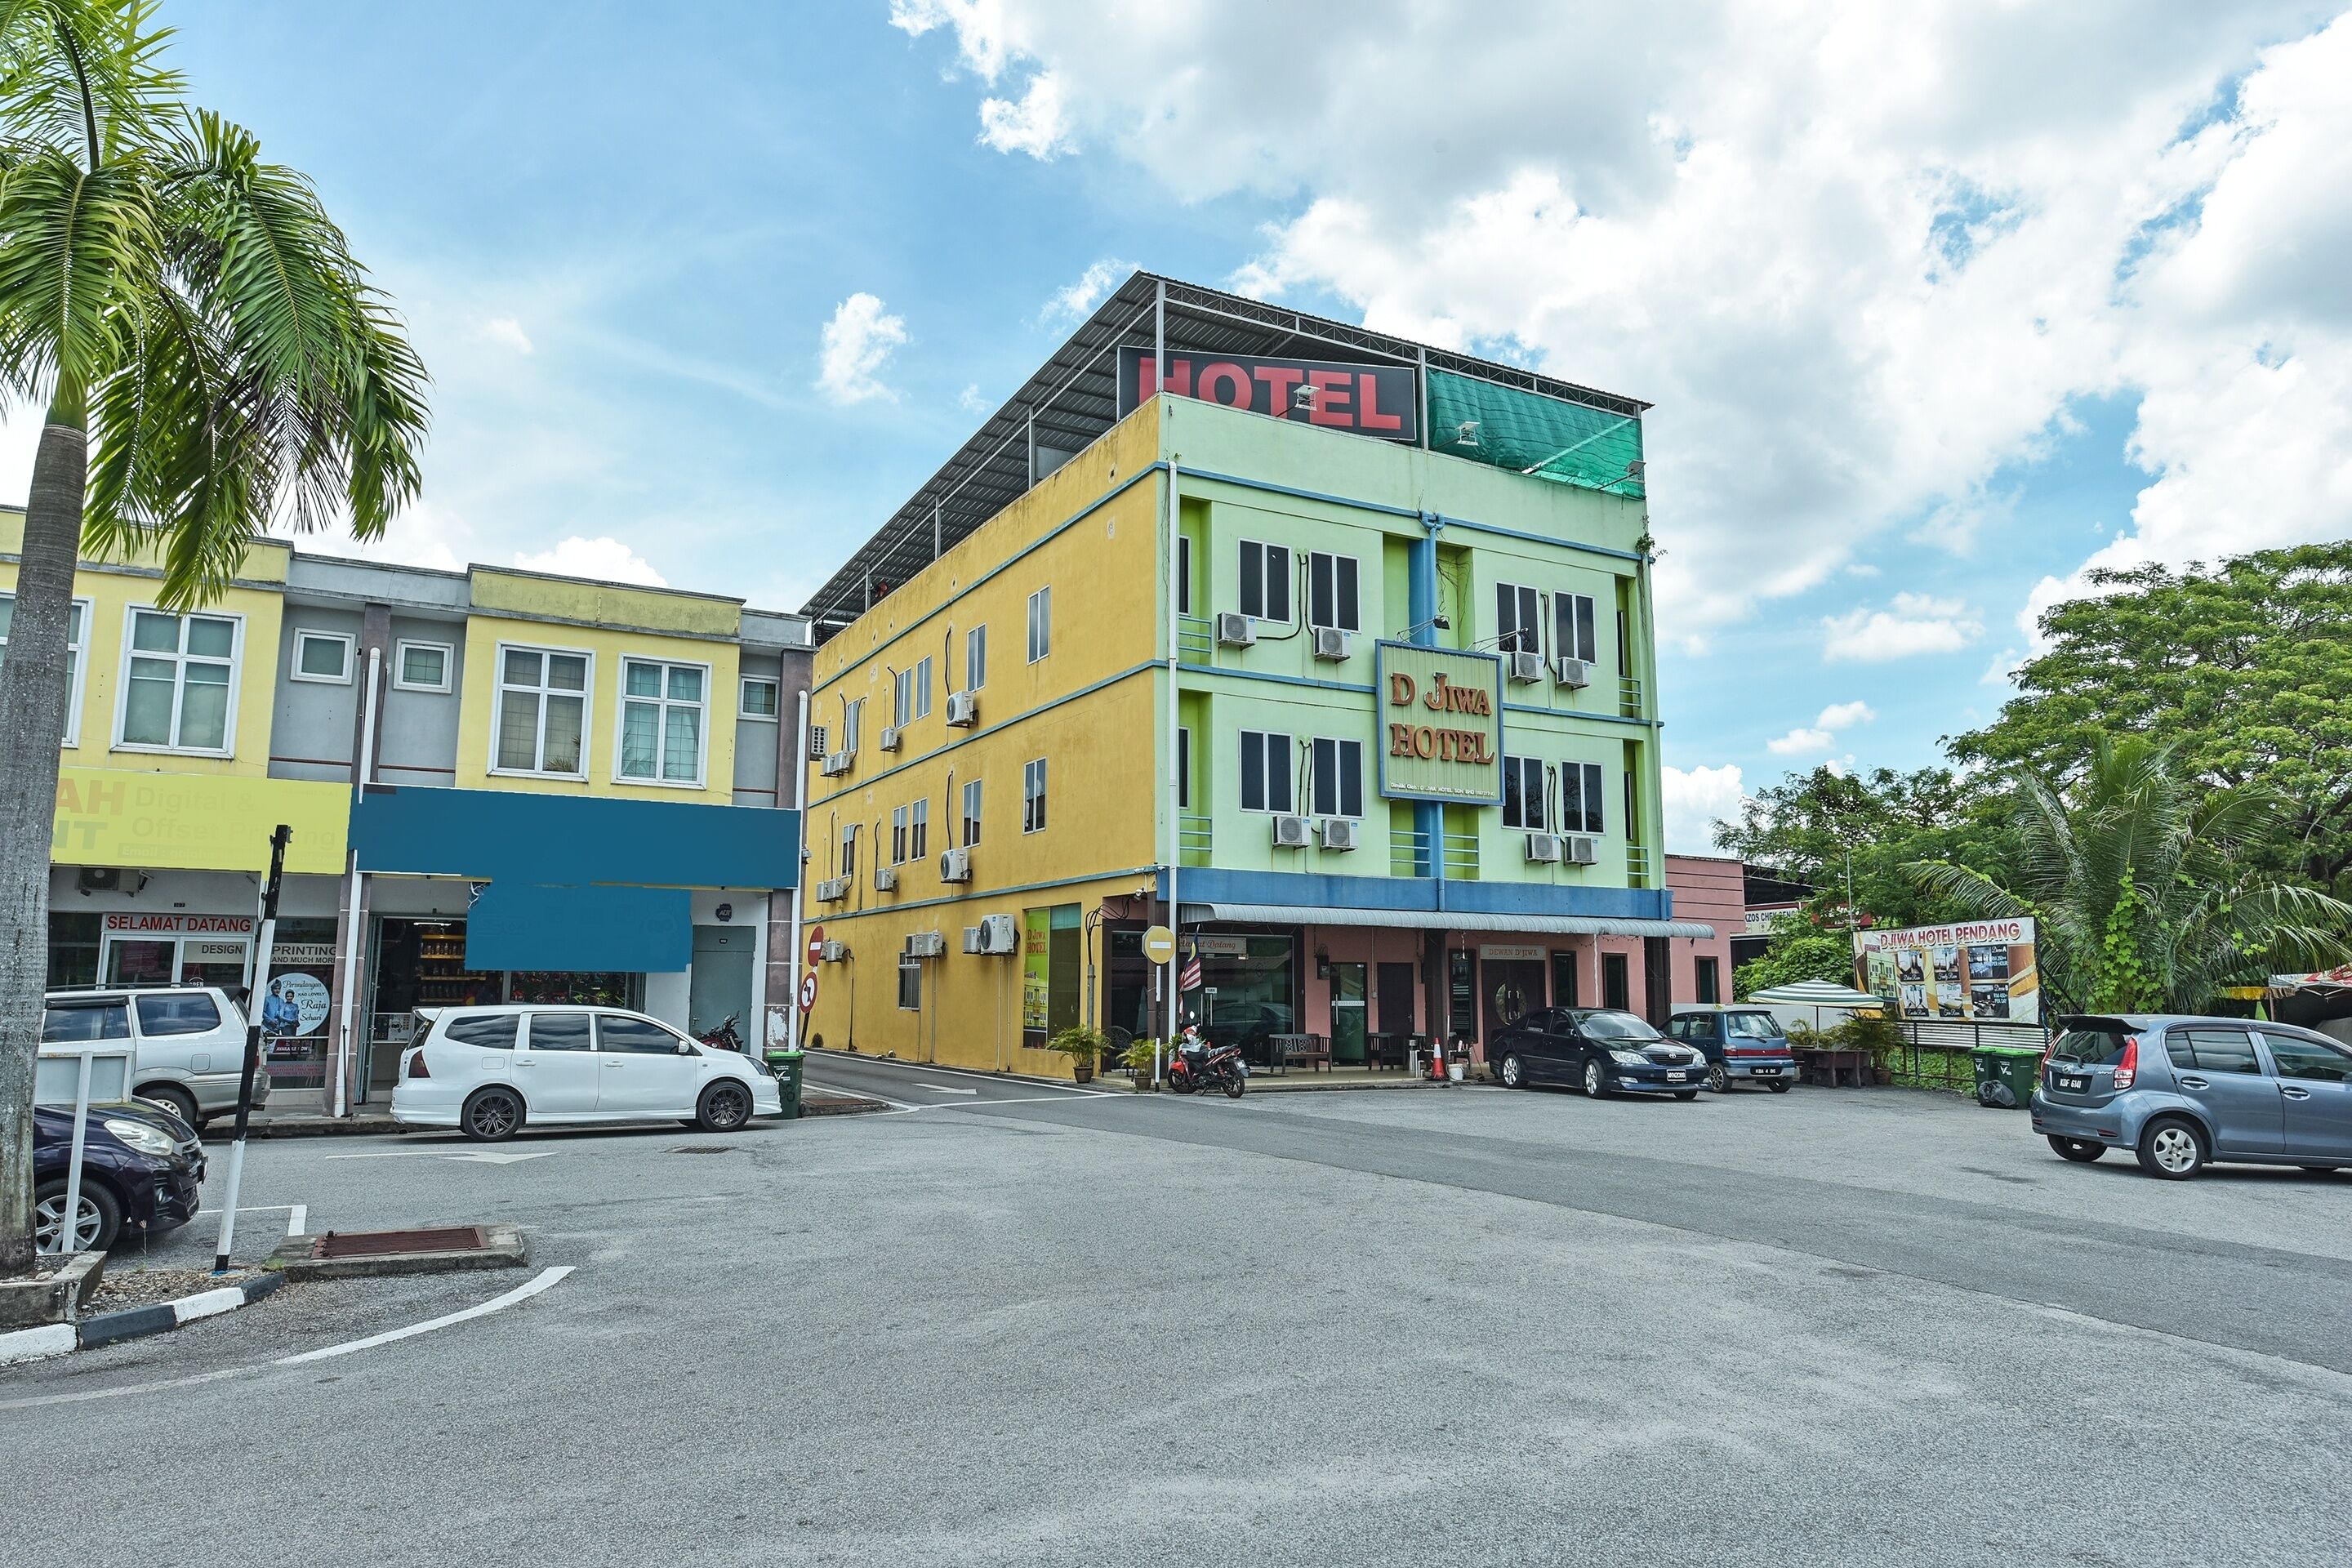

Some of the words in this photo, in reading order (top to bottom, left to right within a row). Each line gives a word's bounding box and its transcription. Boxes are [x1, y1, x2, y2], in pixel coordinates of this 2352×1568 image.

[1139, 357, 1401, 430] HOTEL
[1390, 672, 1415, 706] D
[1389, 723, 1495, 764] HOTEL
[136, 786, 225, 813] Digital
[236, 791, 256, 812] &
[132, 816, 218, 840] Offset
[107, 915, 183, 931] SELAMAT
[187, 917, 251, 932] DATANG
[1918, 928, 1953, 947] HOTEL
[1955, 922, 2021, 944] PENDANG
[202, 945, 243, 954] DESIGN
[272, 946, 336, 956] PRINTING
[1027, 942, 1046, 953] HOTEL
[301, 1000, 327, 1011] Raja
[2060, 1079, 2069, 1087] KDF
